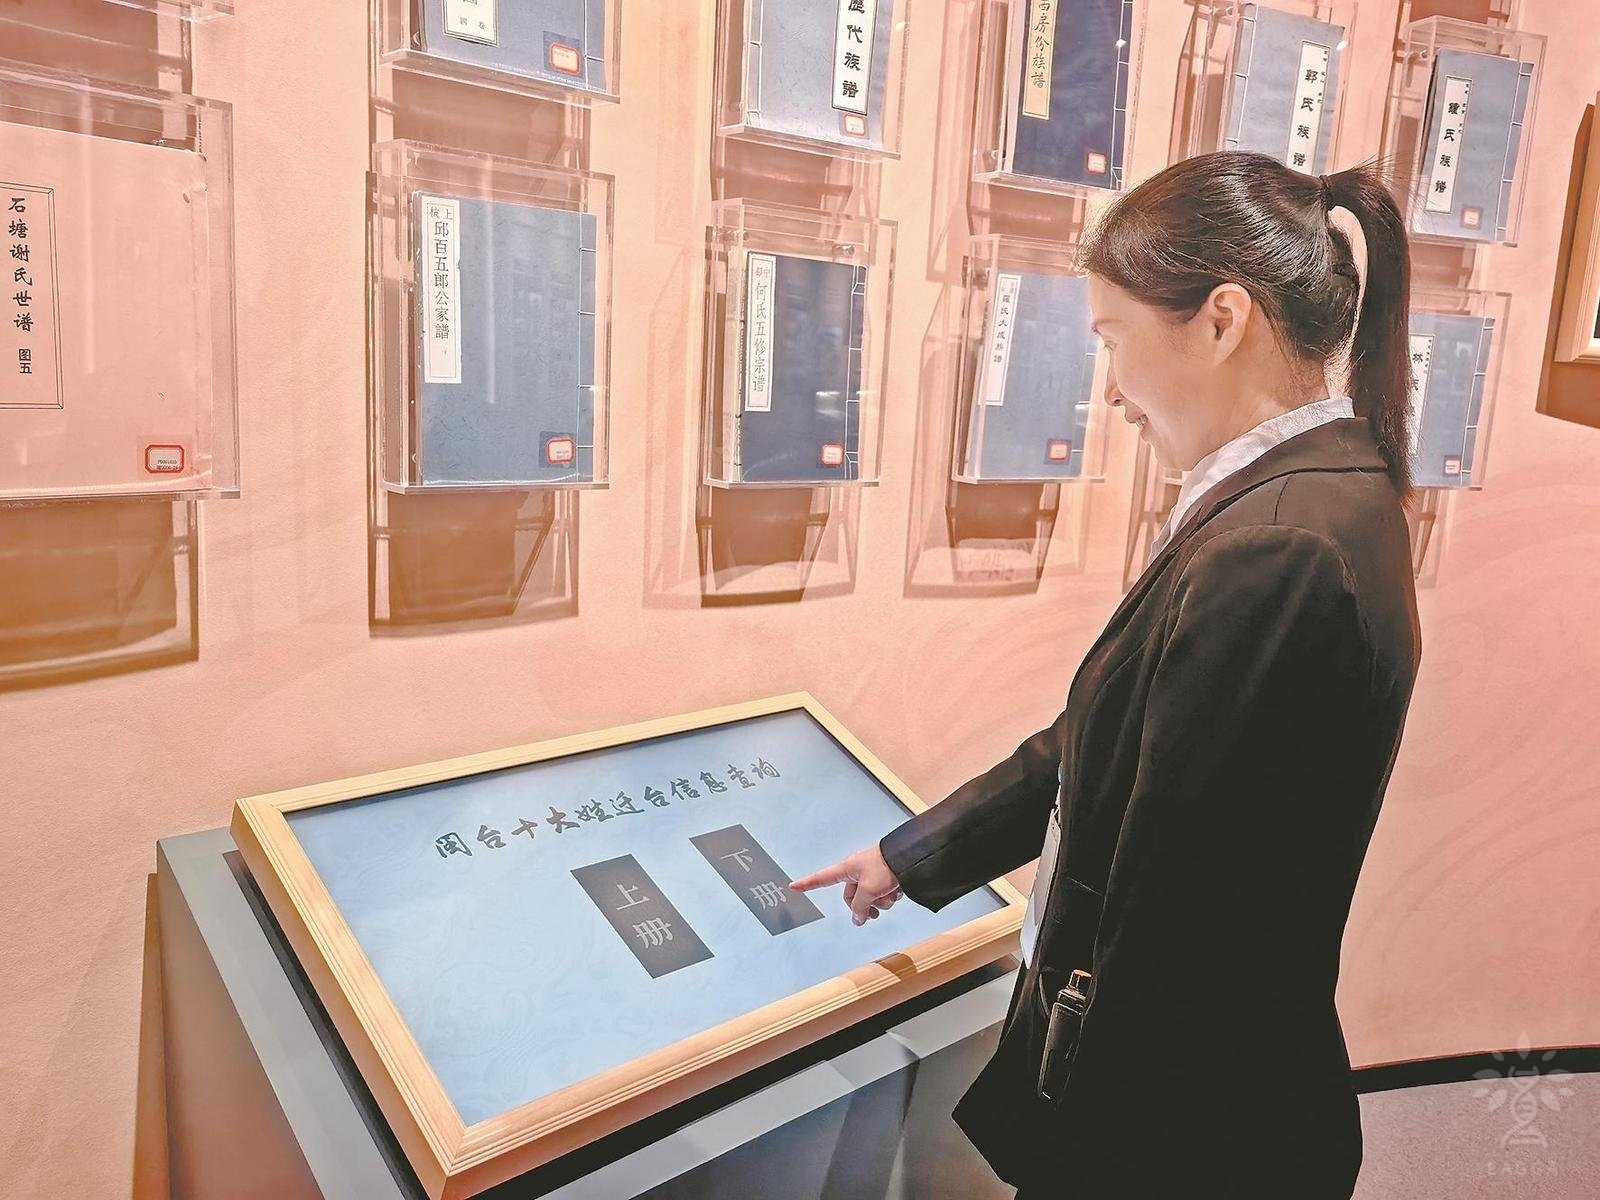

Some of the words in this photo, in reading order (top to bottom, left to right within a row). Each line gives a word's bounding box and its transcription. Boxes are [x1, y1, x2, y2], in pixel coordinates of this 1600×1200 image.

[8, 197, 34, 333] 石塘谢氏世谱
[433, 220, 450, 341] 邱百五郎公家譜
[18, 348, 33, 375] 图五
[435, 756, 781, 859] 闽台十大姓迁台信息查询
[615, 882, 674, 950] 上册
[719, 848, 786, 911] 下册
